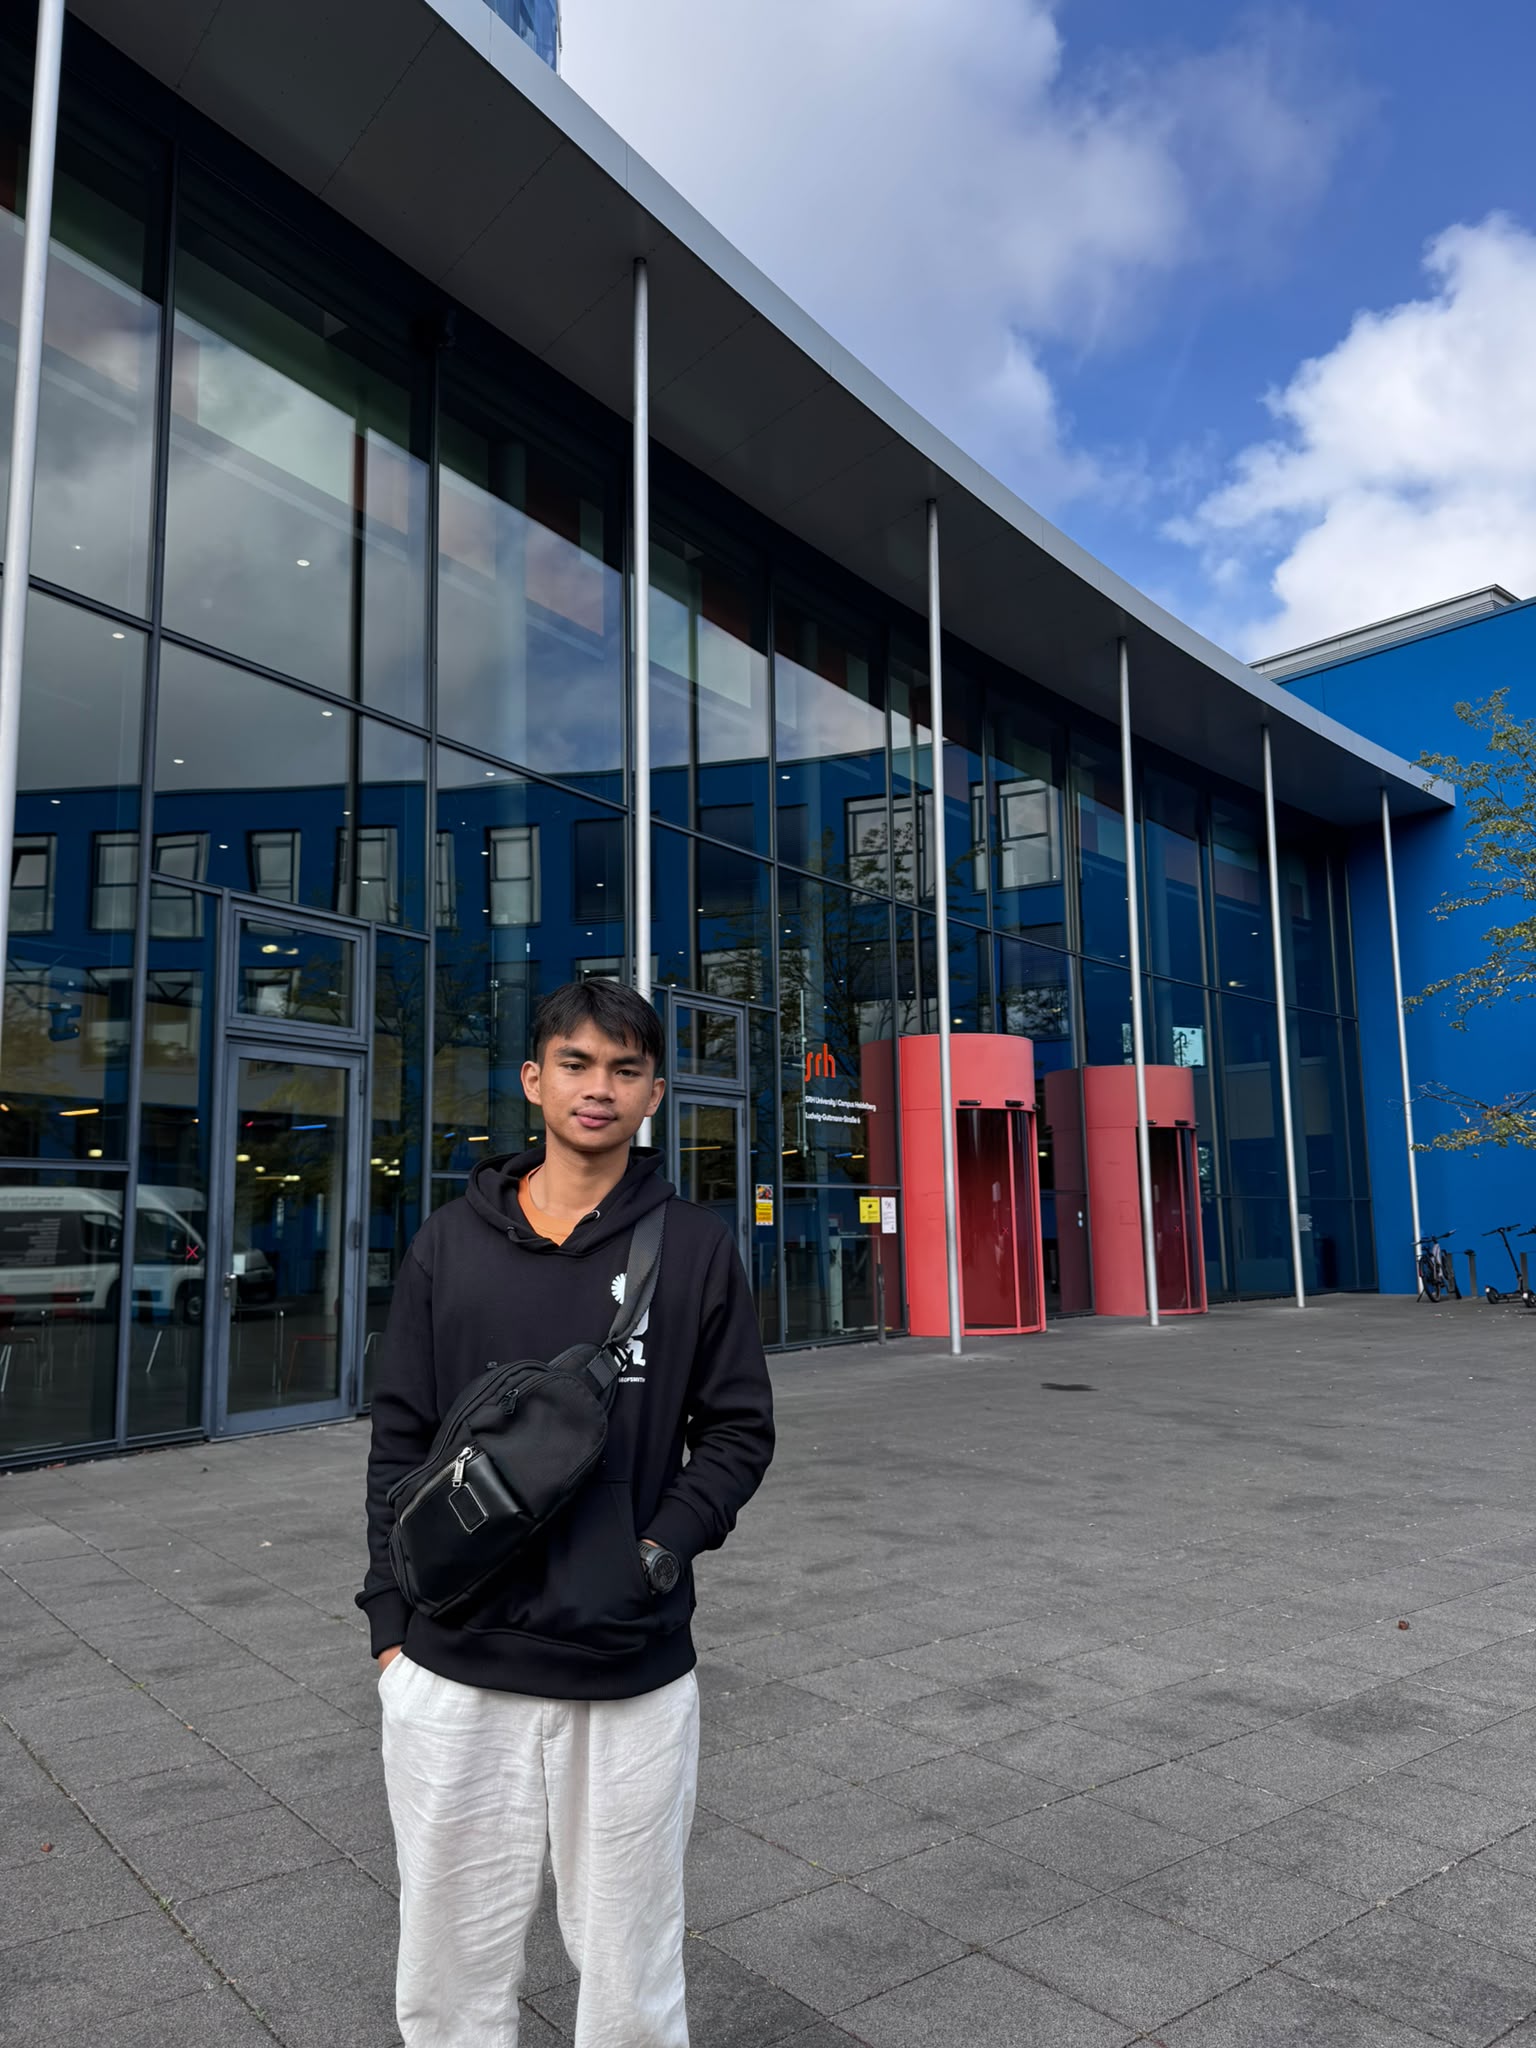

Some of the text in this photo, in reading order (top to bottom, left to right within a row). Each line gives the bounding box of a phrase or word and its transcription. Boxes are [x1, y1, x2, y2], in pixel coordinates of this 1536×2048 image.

[804, 1043, 836, 1082] srh
[805, 1095, 815, 1103] SRH
[816, 1096, 836, 1107] University
[838, 1099, 854, 1108] Campus
[855, 1101, 877, 1112] Heidelberg
